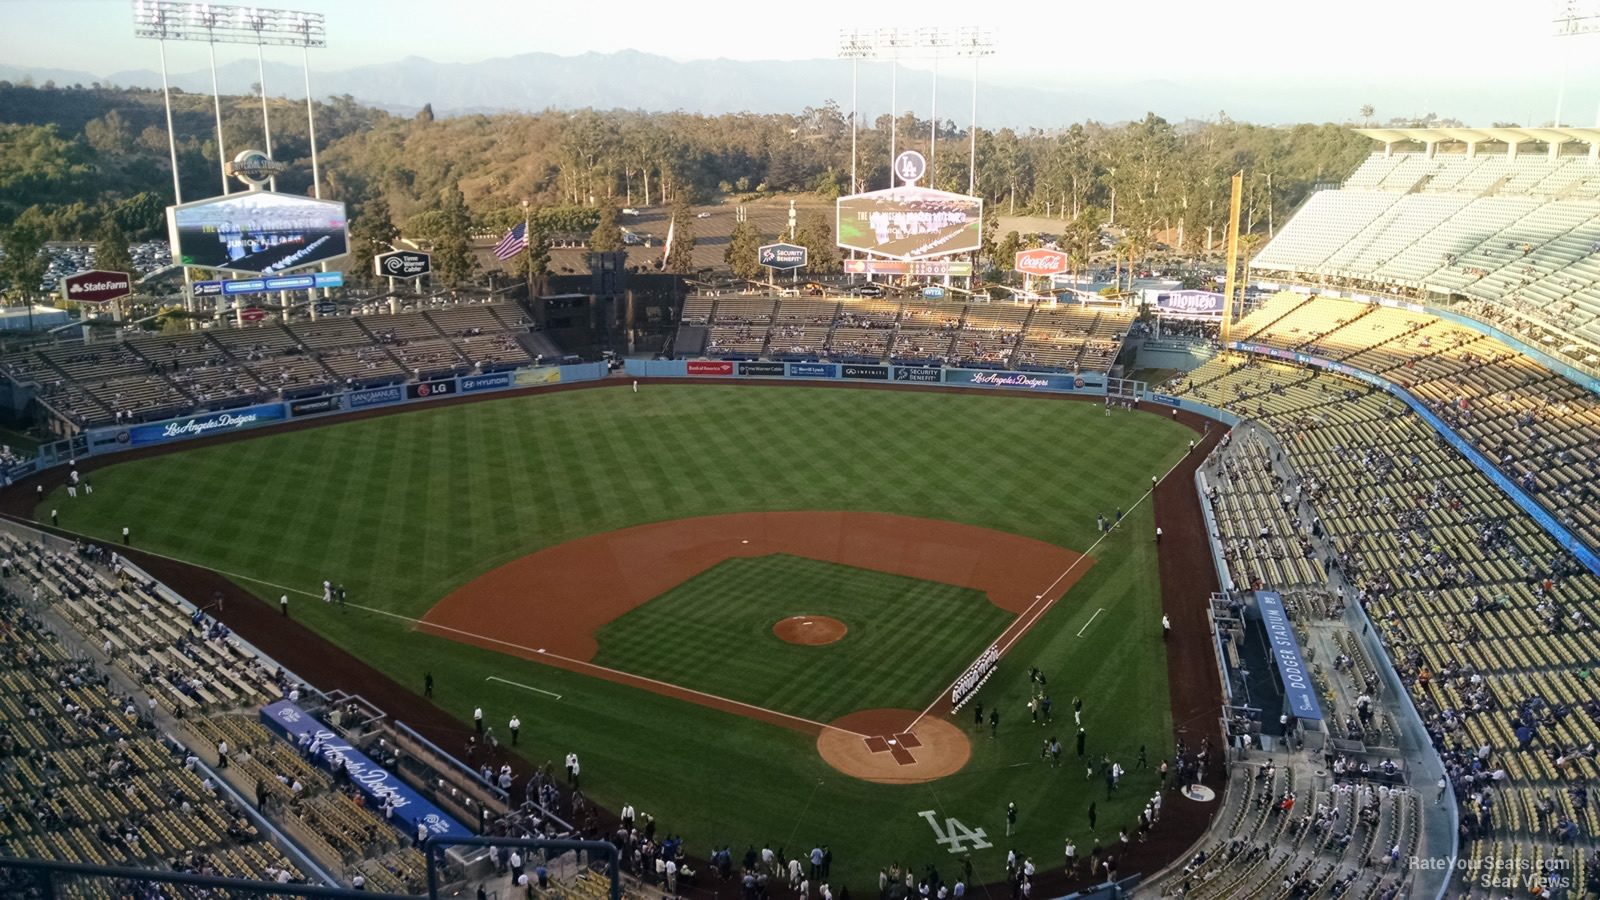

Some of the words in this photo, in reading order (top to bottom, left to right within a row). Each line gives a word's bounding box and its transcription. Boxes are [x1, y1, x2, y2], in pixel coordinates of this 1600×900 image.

[901, 155, 917, 177] LA
[857, 211, 868, 220] THE
[1241, 343, 1254, 352] Text
[476, 377, 508, 386] HYUNDAI
[1015, 374, 1049, 388] Dodgers
[371, 389, 400, 398] MANUEL
[432, 384, 447, 394] LG
[180, 419, 218, 434] Angeles
[217, 414, 257, 427] Dodgers
[1267, 609, 1292, 646] STADIUM
[1281, 649, 1307, 690] DODGER
[897, 810, 993, 853] LA
